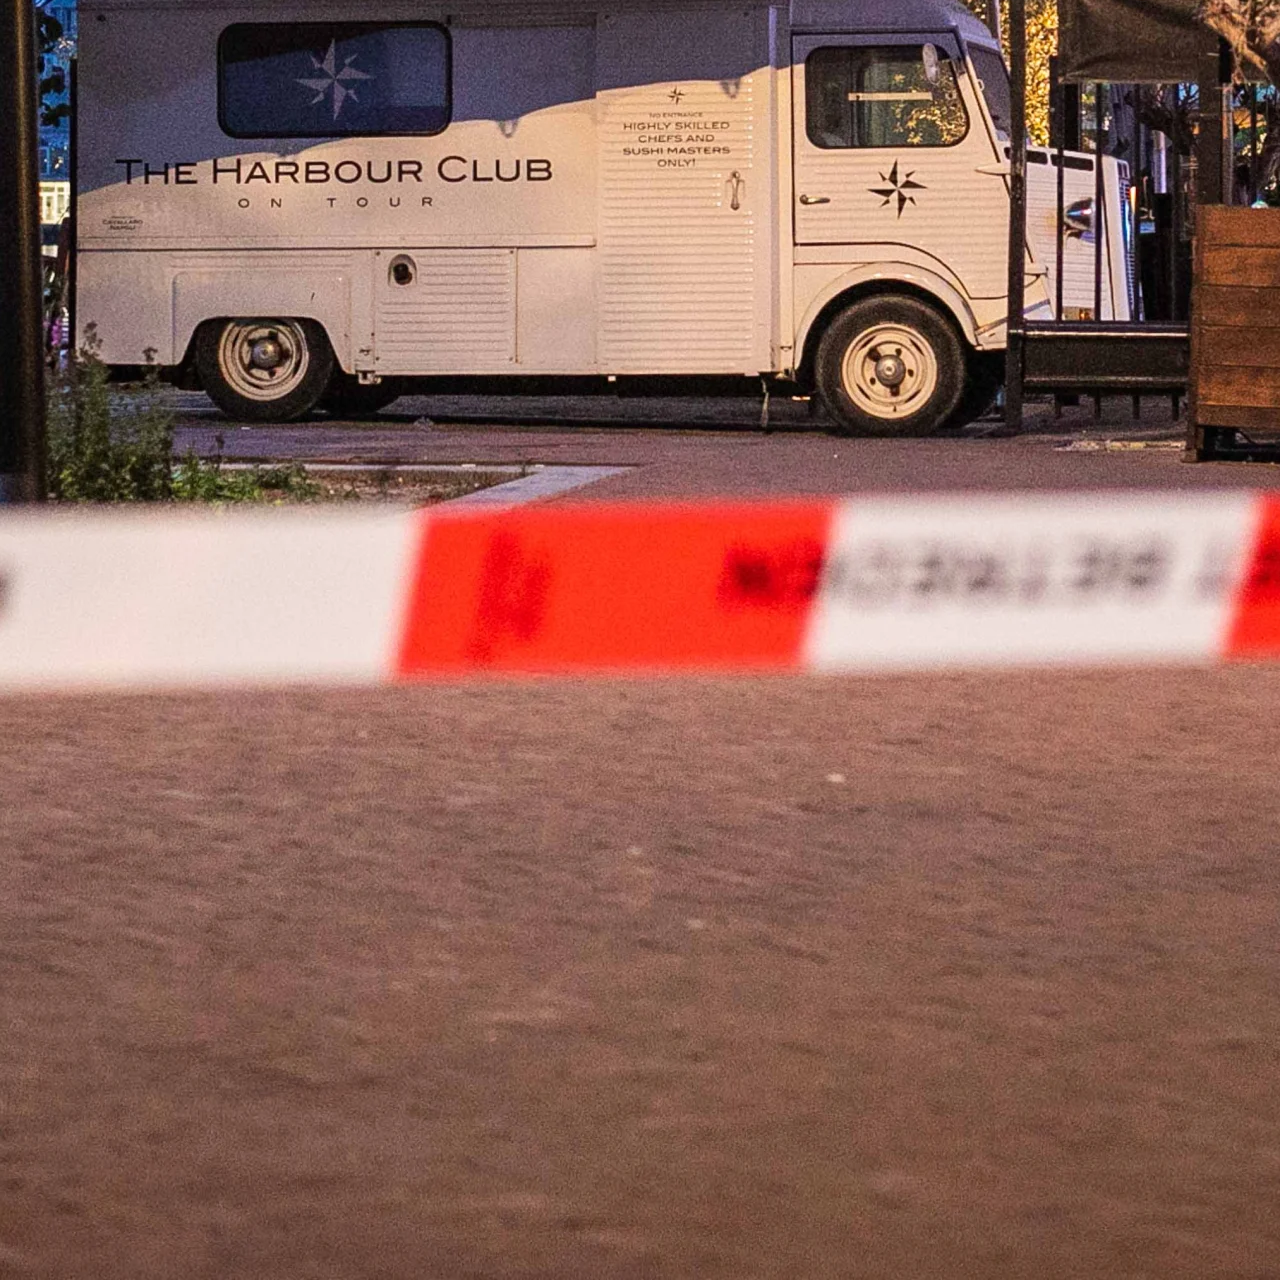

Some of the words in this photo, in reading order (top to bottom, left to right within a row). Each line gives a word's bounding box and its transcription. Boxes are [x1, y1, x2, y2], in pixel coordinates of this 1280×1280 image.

[623, 122, 672, 131] HIGHLY
[675, 121, 731, 130] SKILLED
[638, 134, 683, 143] CHEFS
[686, 134, 716, 143] AND
[623, 147, 664, 156] SUSHI
[667, 146, 731, 155] MASTERS
[657, 158, 696, 168] ONLY!
[114, 158, 198, 185] THE
[212, 157, 424, 184] HARBOUR
[436, 155, 553, 182] CLUB
[237, 197, 283, 209] ON
[326, 196, 434, 209] TOUR
